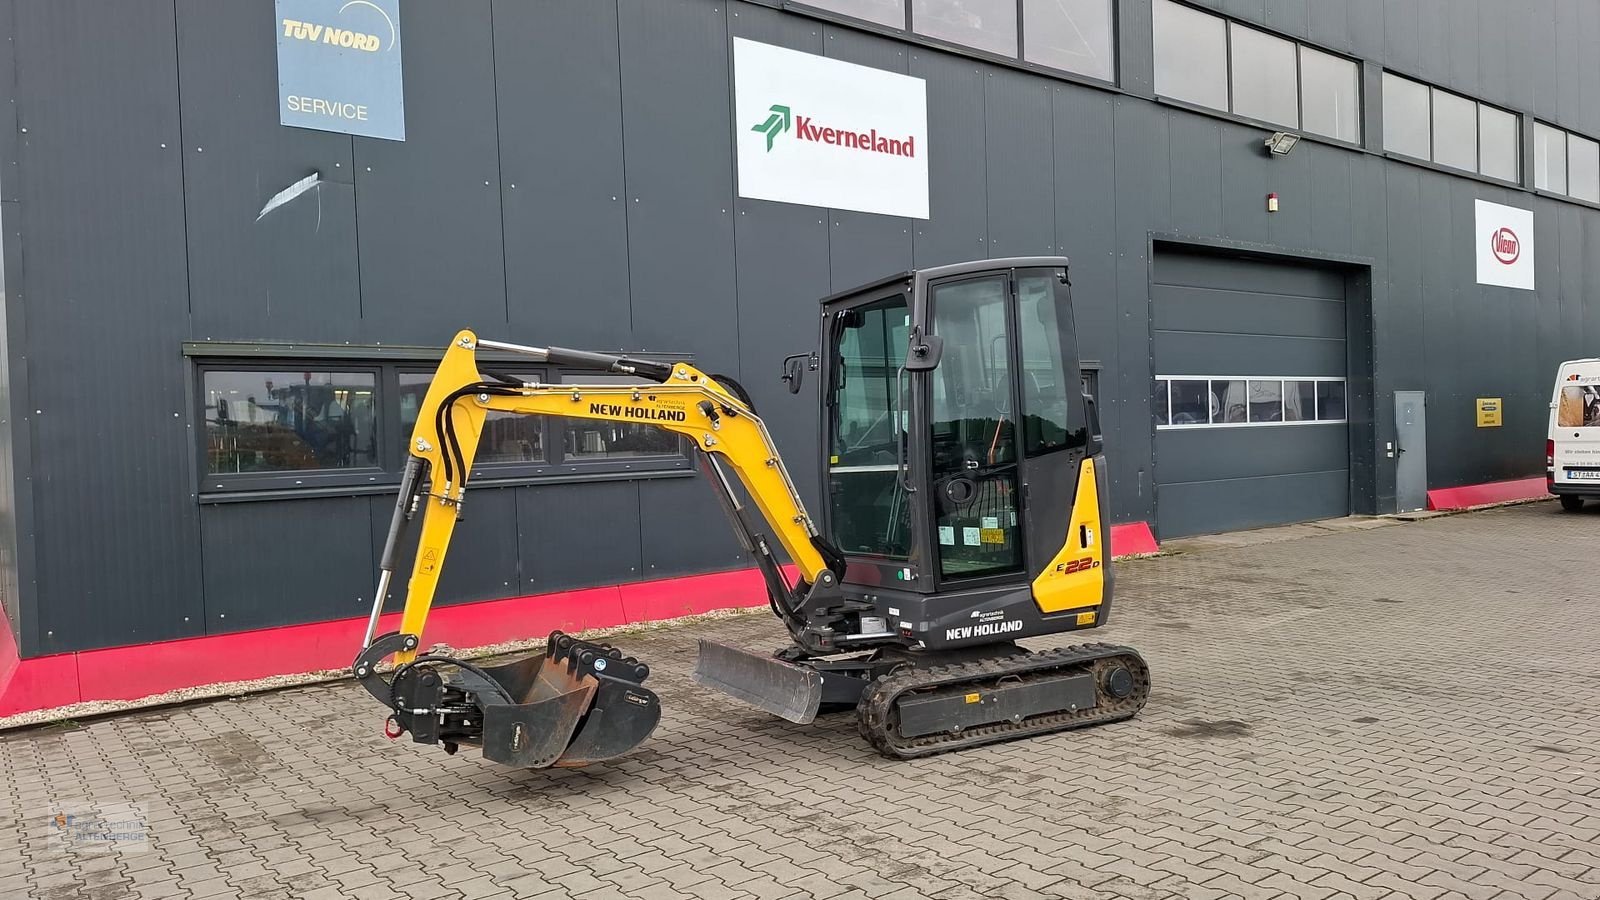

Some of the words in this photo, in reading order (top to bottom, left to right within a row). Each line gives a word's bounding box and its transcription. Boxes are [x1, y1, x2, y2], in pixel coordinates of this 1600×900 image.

[282, 19, 322, 41] TÜV
[323, 27, 380, 52] NORD
[287, 95, 368, 121] SERVICE
[795, 115, 914, 158] Kverneland
[1493, 228, 1517, 255] Vicon
[590, 402, 621, 417] NEW
[624, 406, 686, 422] HOLLAND
[946, 626, 972, 641] NEW
[973, 620, 1023, 637] HOLLAND
